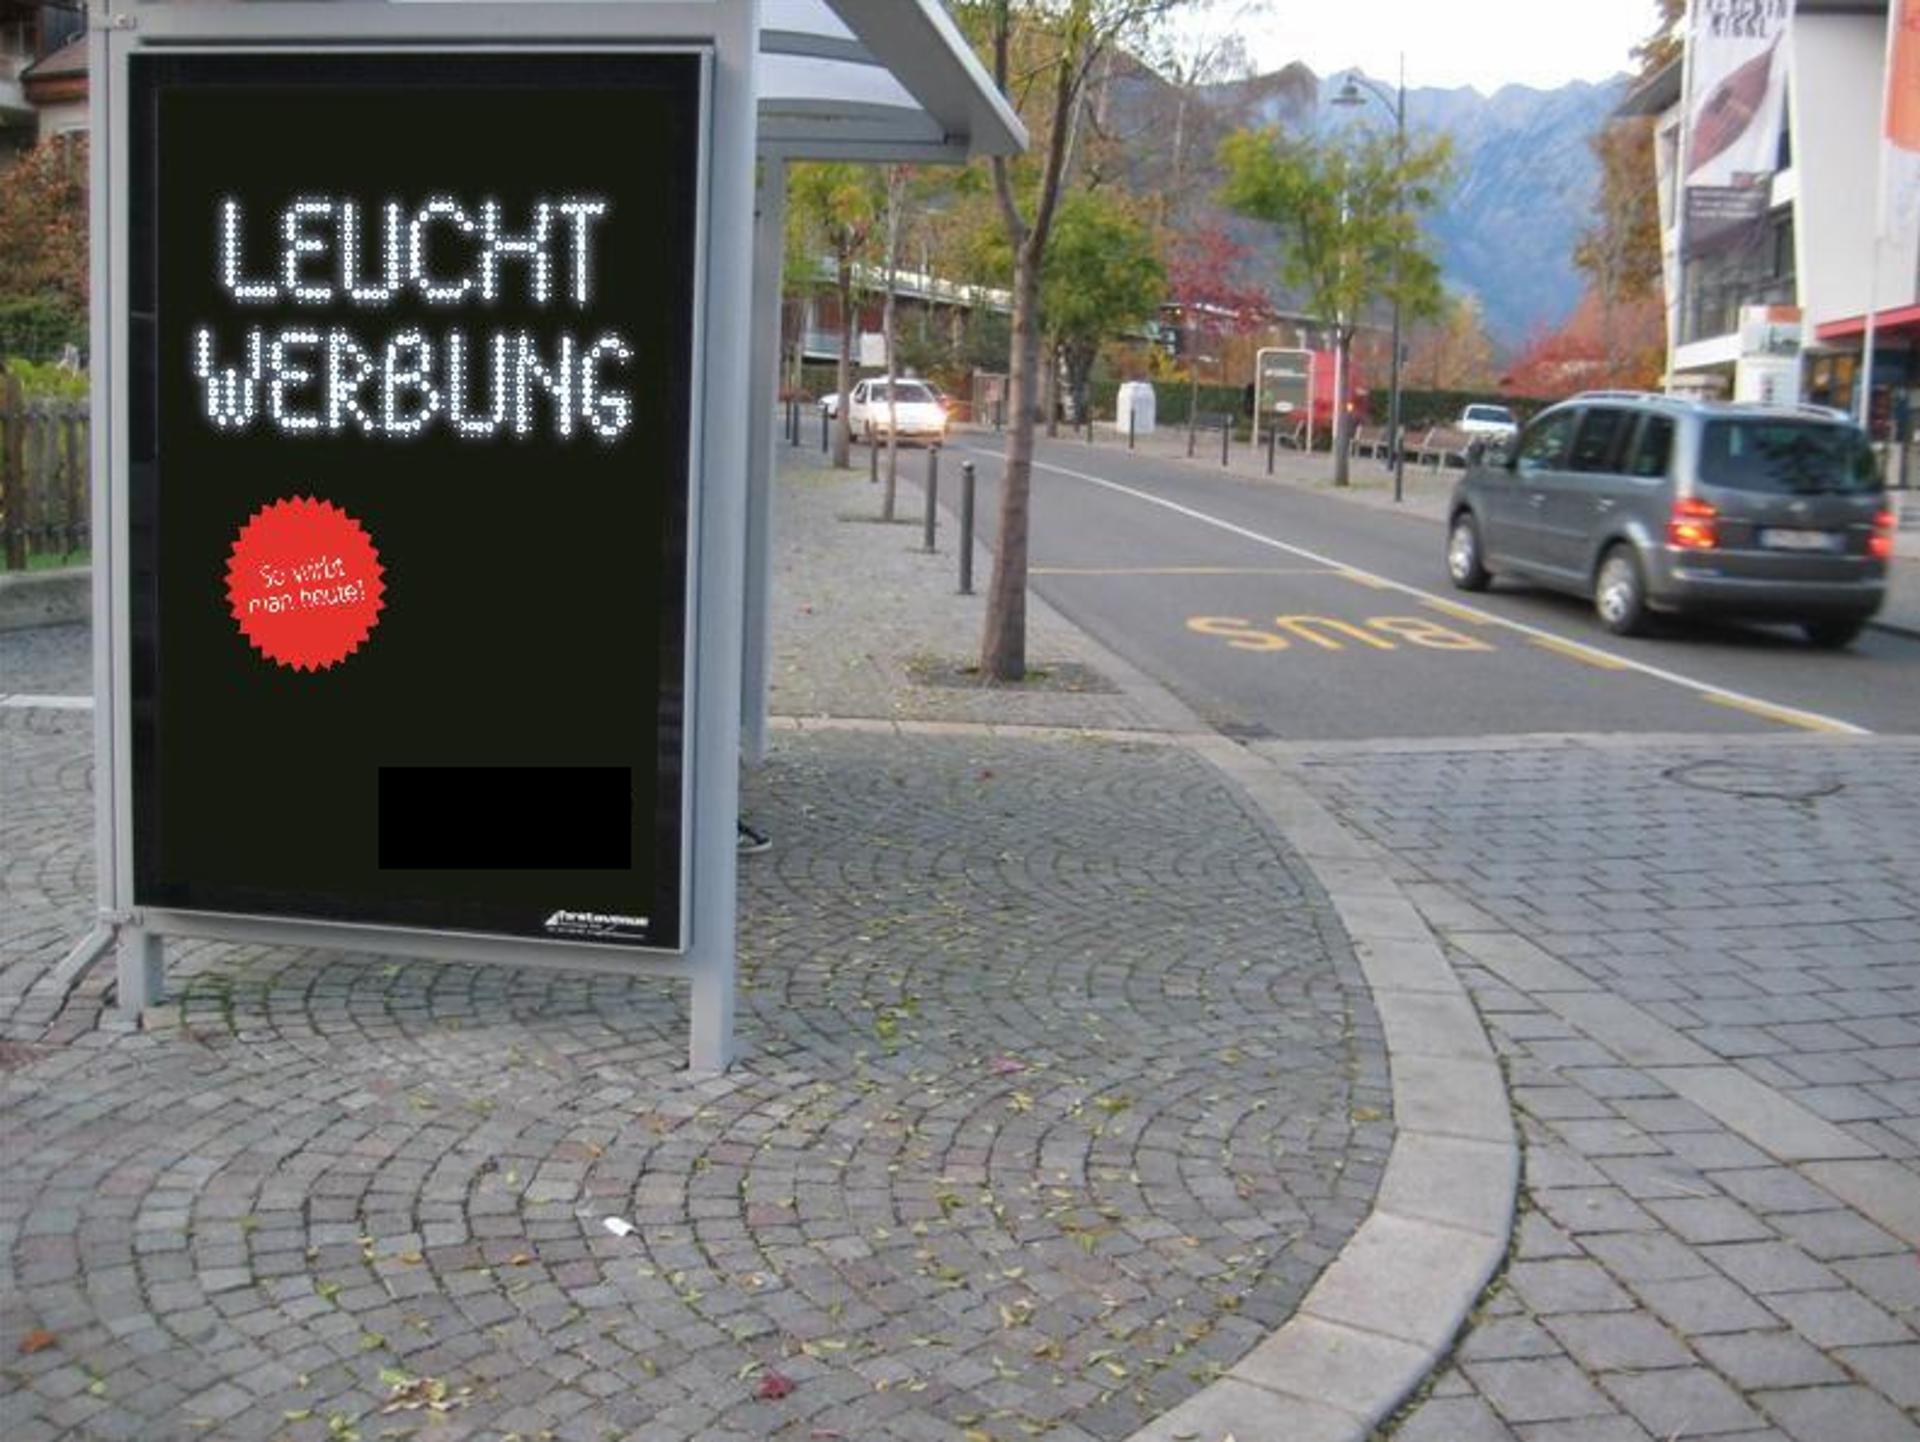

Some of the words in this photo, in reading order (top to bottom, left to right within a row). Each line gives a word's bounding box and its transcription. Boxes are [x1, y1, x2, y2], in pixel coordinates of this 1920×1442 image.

[222, 198, 607, 303] LEUCHT
[194, 328, 632, 438] WERBUNG
[259, 564, 286, 589] So
[249, 593, 293, 613] man
[1186, 614, 1497, 650] BUS
